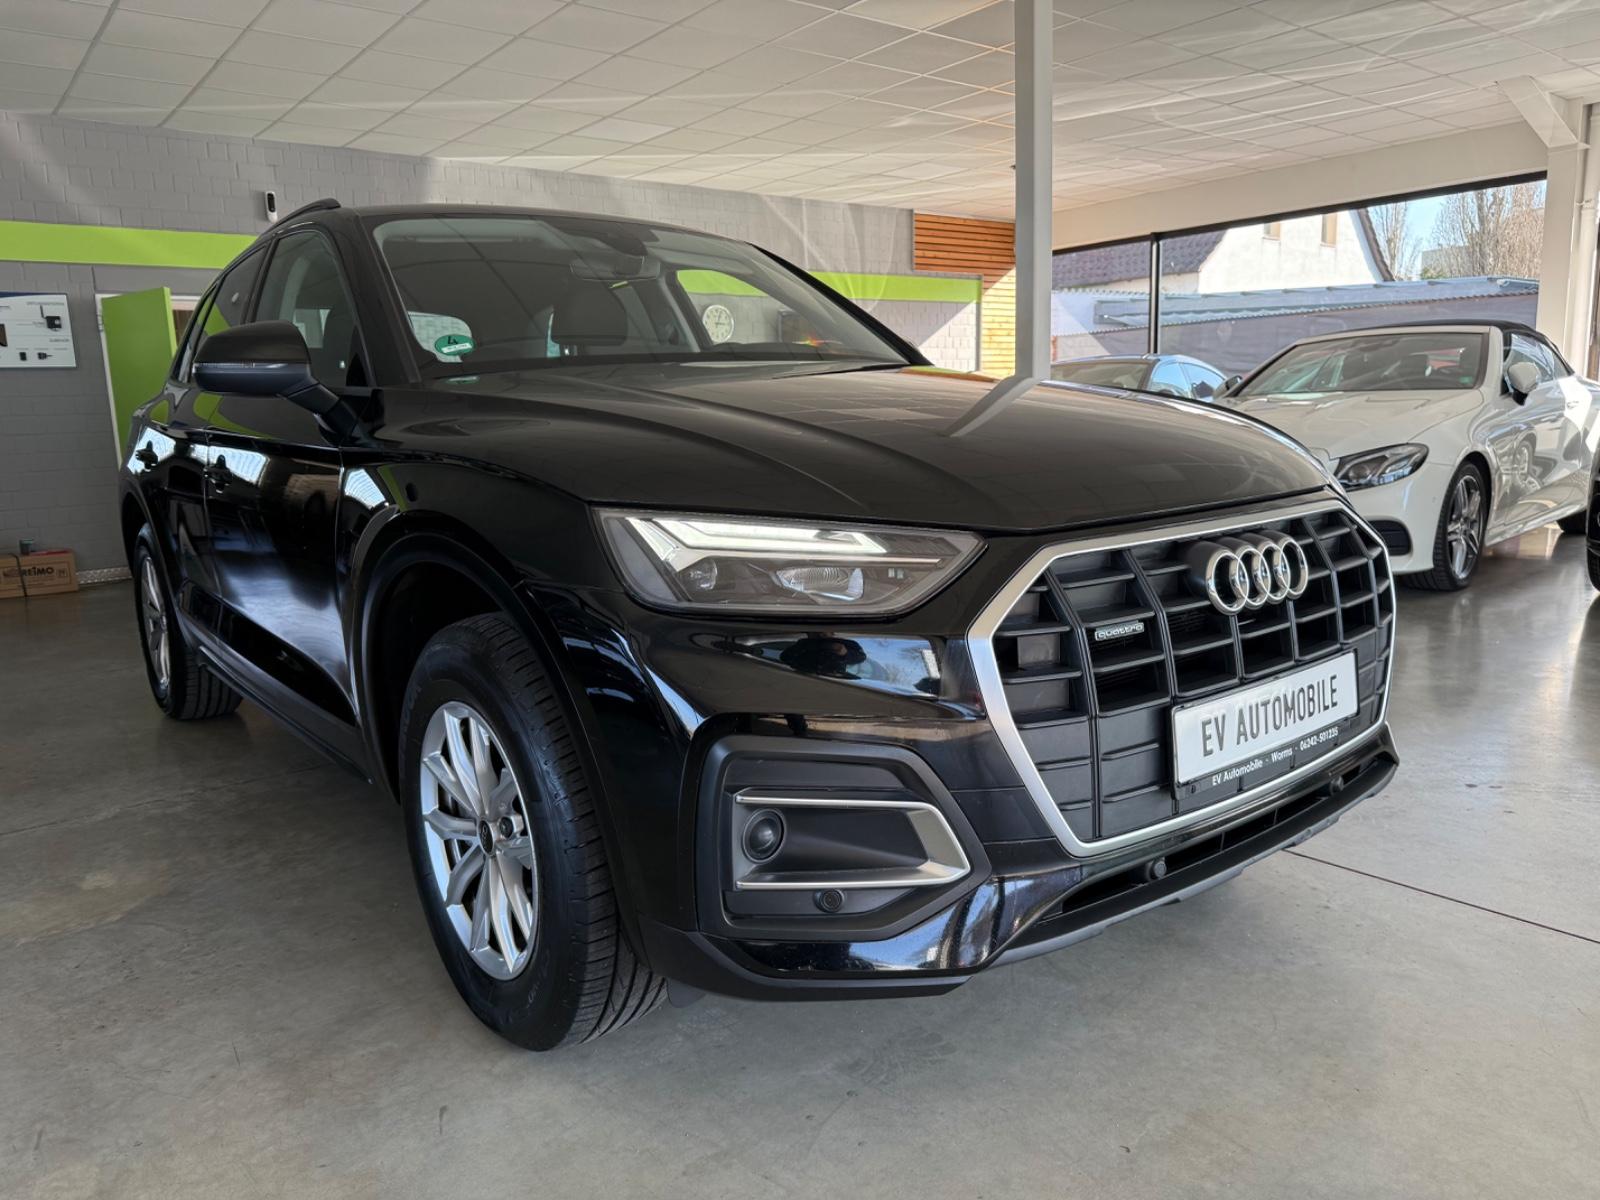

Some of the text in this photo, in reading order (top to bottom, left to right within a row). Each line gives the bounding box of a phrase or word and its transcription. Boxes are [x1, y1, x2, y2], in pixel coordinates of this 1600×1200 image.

[1096, 622, 1144, 640] quattro
[1201, 674, 1338, 757] EV AUTOMOBILE
[1211, 774, 1222, 786] EV
[1223, 759, 1263, 782] Automobile
[1271, 747, 1293, 763] Worms
